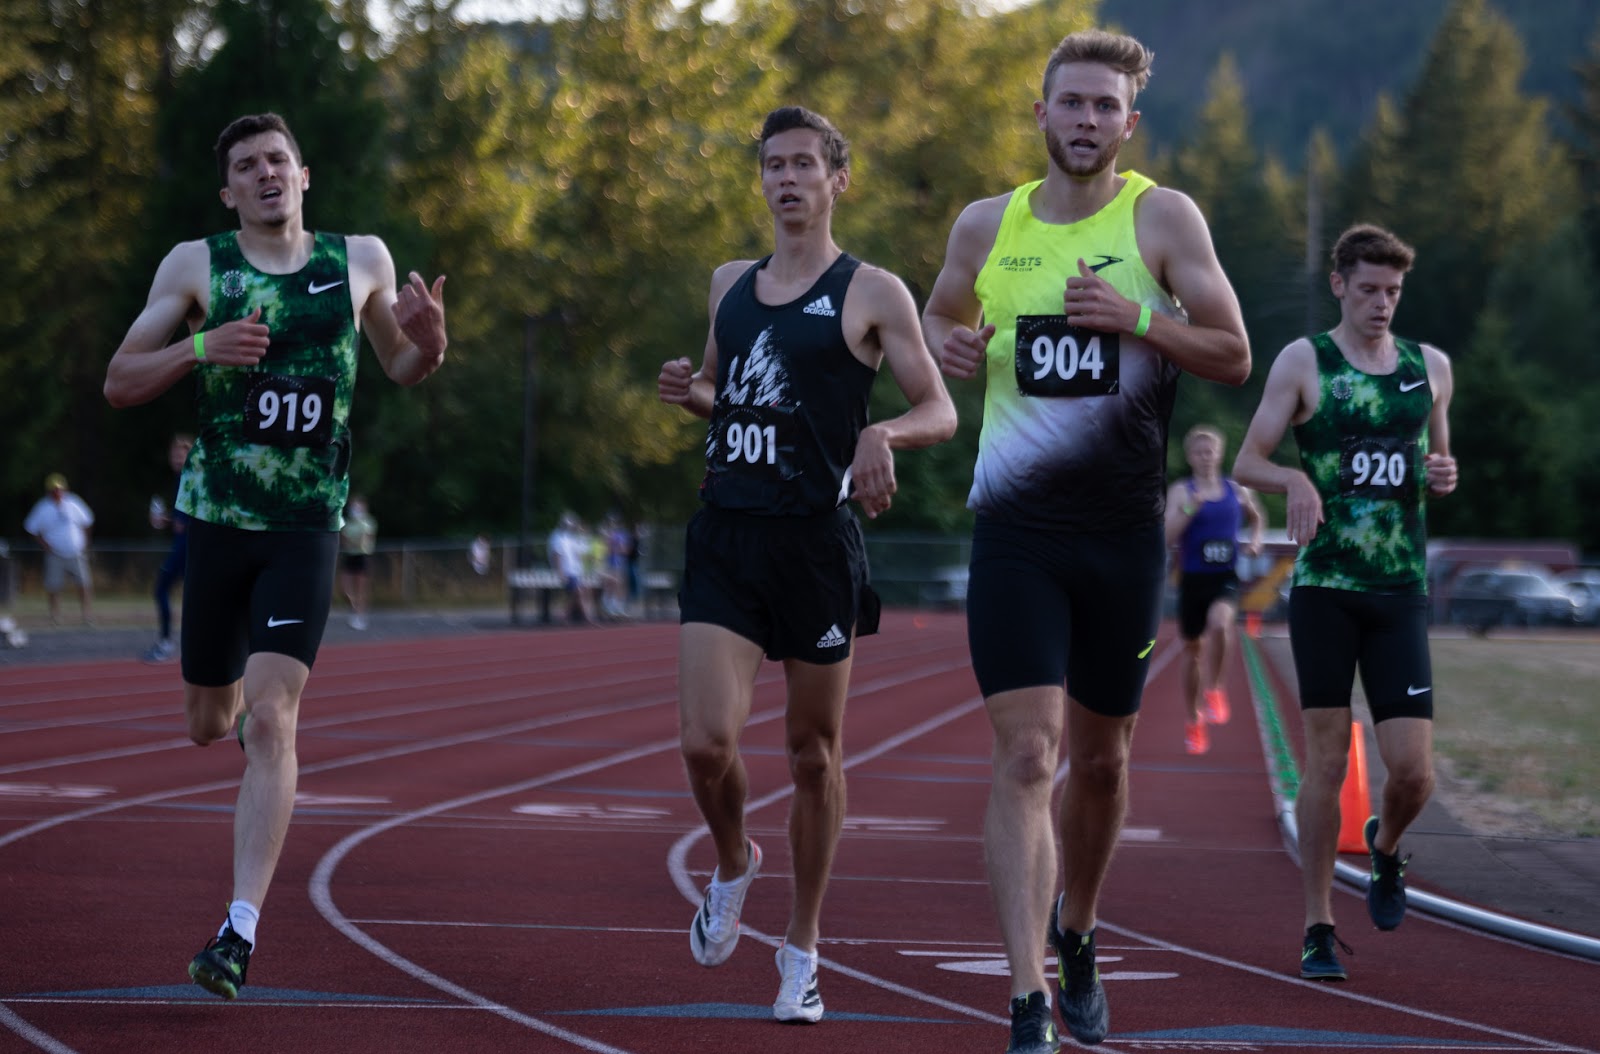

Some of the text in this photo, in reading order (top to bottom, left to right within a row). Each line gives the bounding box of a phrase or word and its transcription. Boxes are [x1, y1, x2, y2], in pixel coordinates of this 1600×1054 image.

[803, 305, 836, 317] adidas
[1031, 335, 1104, 380] 904
[258, 390, 322, 433] 919
[726, 422, 777, 465] 901
[1351, 451, 1406, 487] 920
[816, 636, 847, 649] adidas
